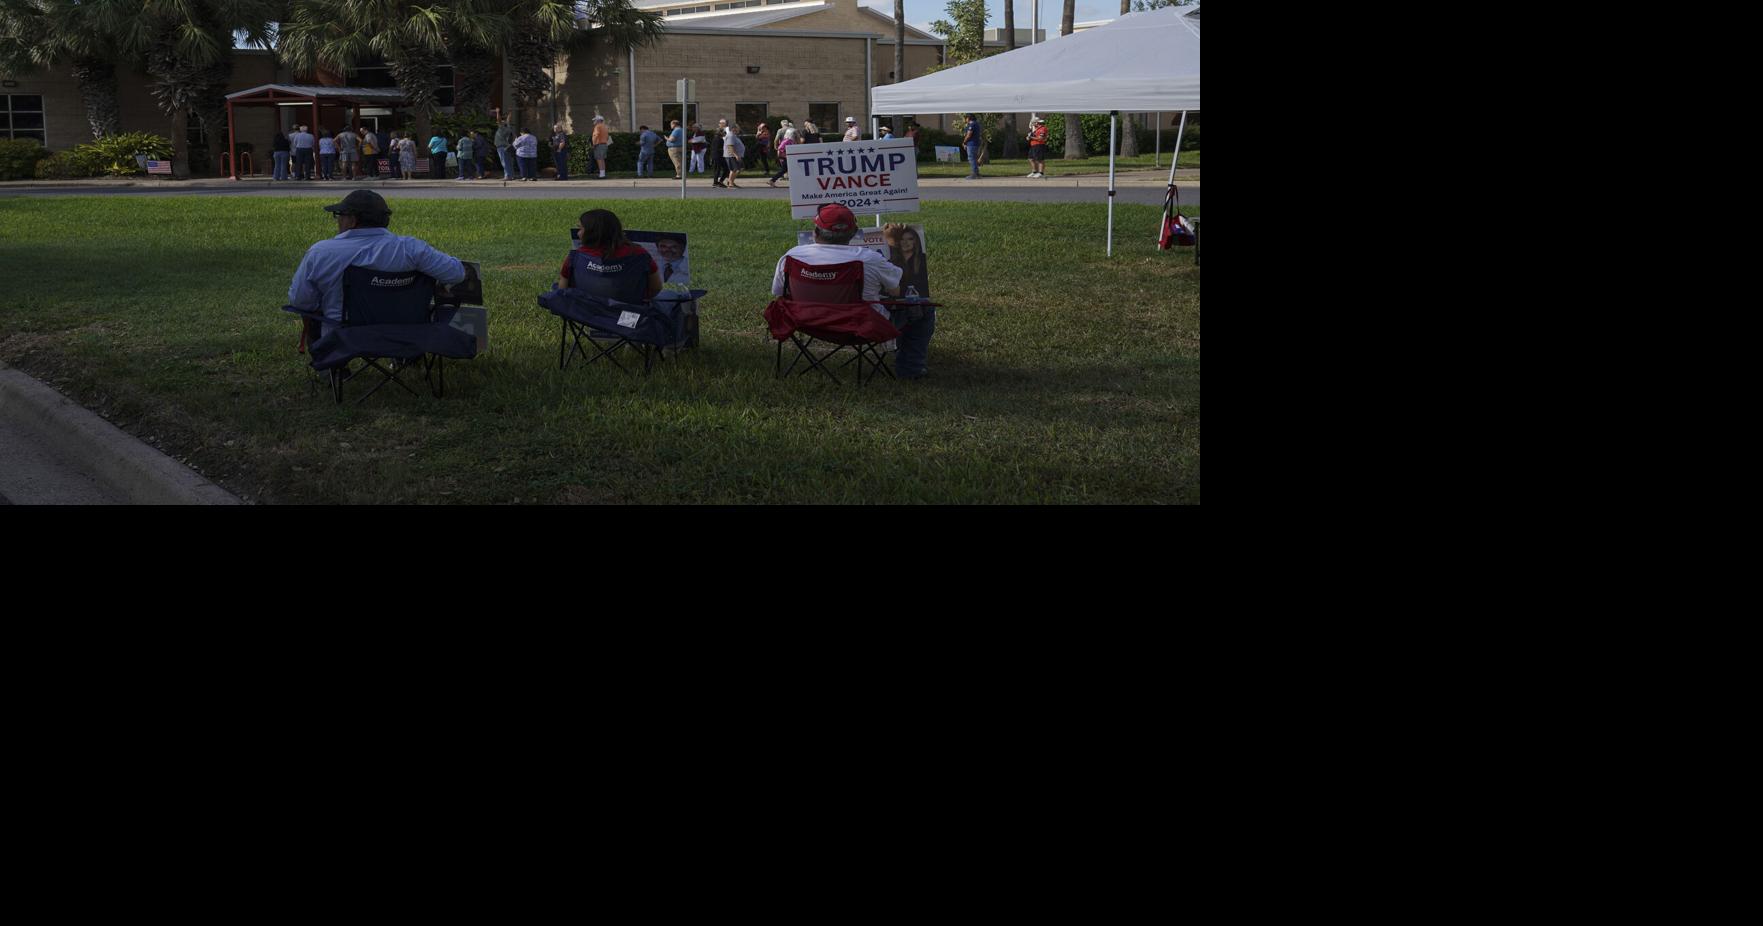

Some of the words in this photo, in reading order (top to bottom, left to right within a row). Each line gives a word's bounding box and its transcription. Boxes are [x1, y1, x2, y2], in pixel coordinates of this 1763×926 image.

[797, 153, 905, 176] TRUMP
[816, 174, 892, 189] VANCE
[824, 191, 858, 199] America
[883, 188, 908, 196] Again!
[840, 198, 871, 207] 2024
[800, 268, 837, 279] Academy
